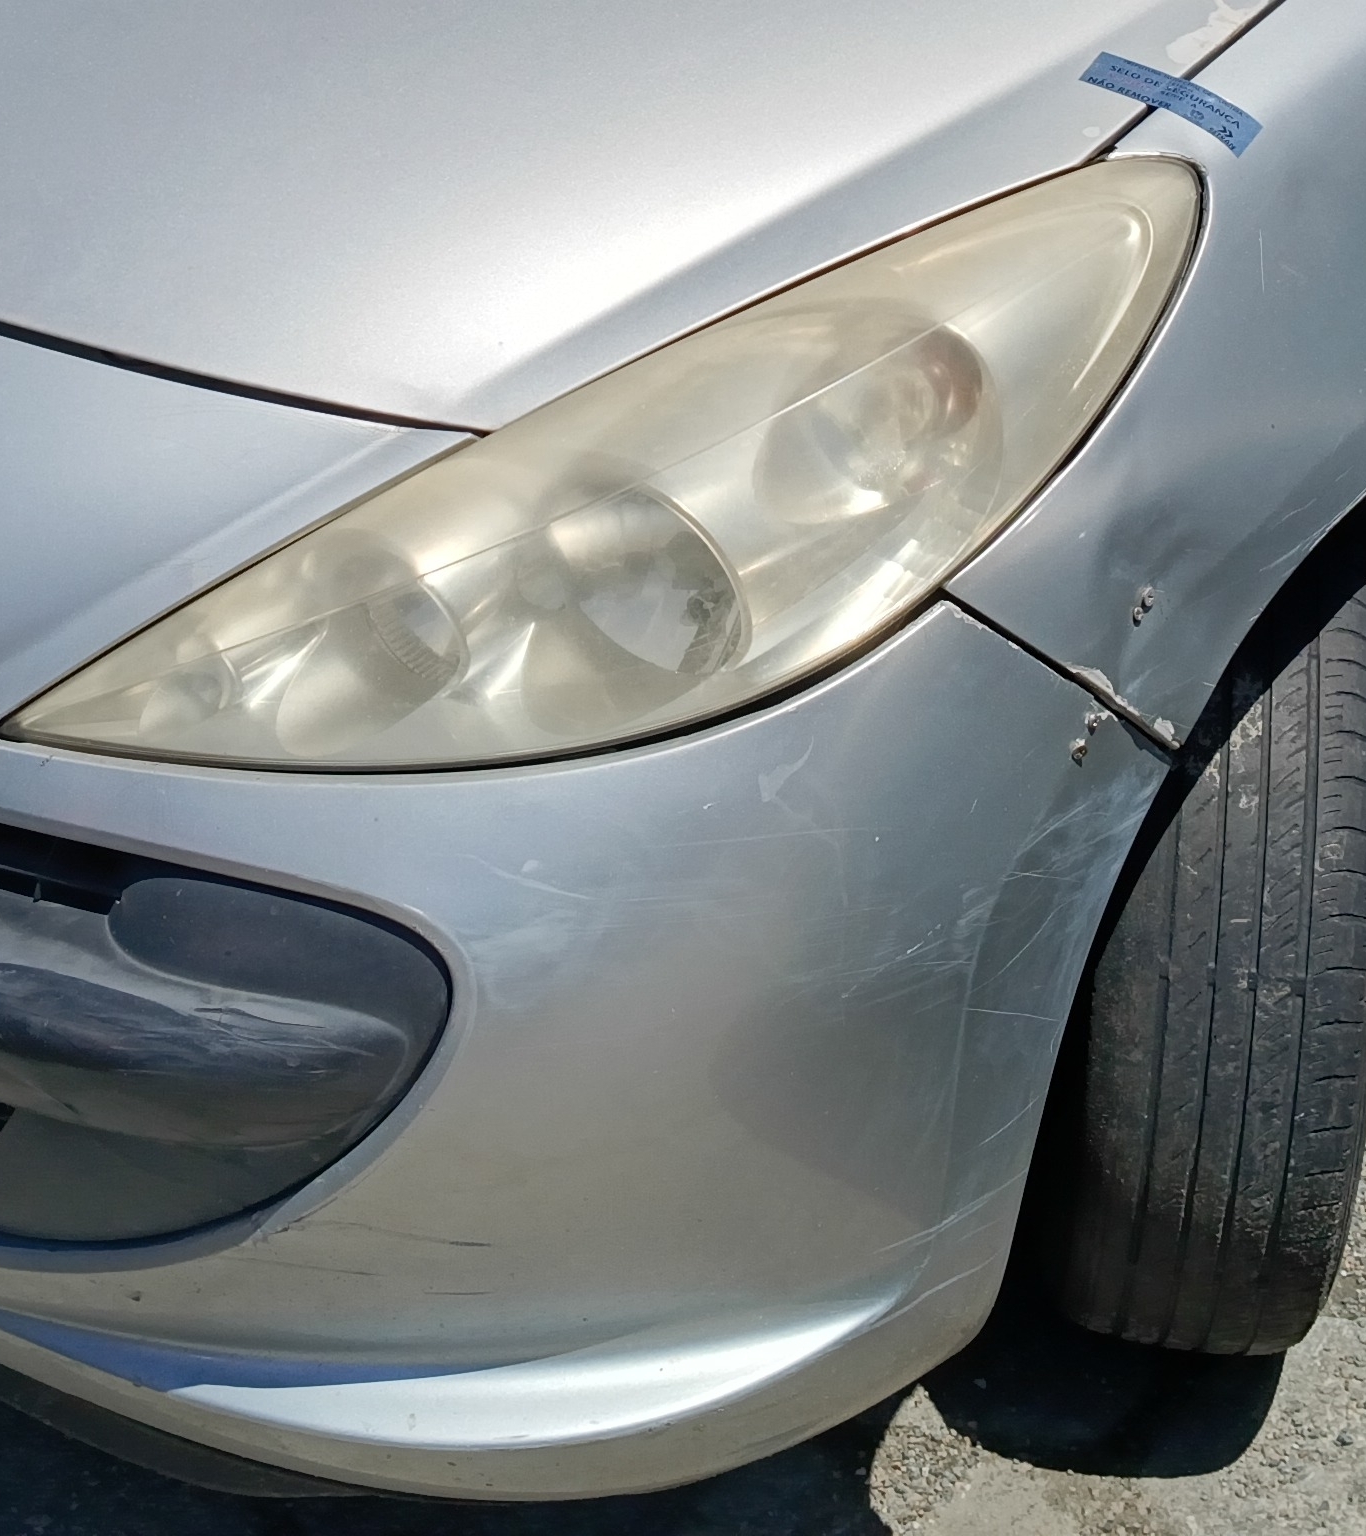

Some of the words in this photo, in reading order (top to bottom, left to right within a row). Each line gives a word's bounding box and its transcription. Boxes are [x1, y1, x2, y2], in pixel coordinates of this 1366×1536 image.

[1109, 64, 1141, 80] SELO
[1144, 77, 1161, 88] DE
[1165, 85, 1241, 130] SEGURANÇA
[1117, 86, 1172, 110] REMOVER
